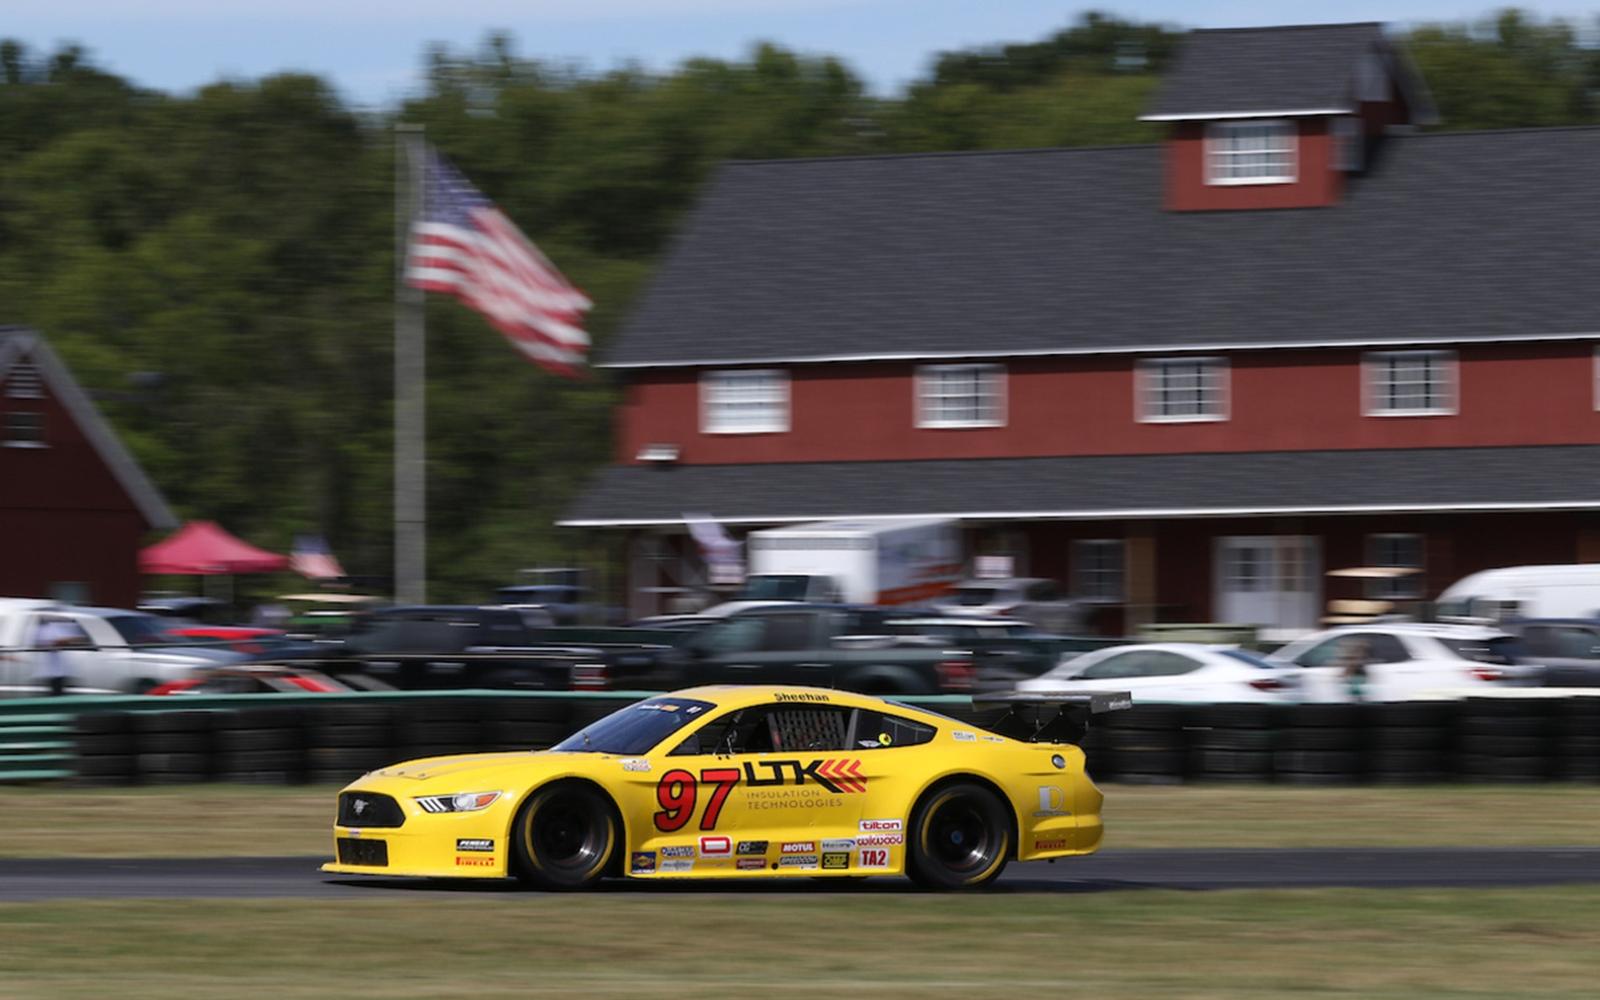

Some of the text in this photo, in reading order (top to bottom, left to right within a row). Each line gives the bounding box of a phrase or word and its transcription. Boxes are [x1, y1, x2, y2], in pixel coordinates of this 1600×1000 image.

[774, 692, 830, 702] Sheehan
[654, 768, 741, 832] 97
[746, 789, 820, 800] INSULATION
[747, 798, 843, 810] TECHNOLOGIES
[862, 821, 900, 830] tilton
[783, 843, 814, 852] MOTUL
[862, 850, 886, 866] TA2
